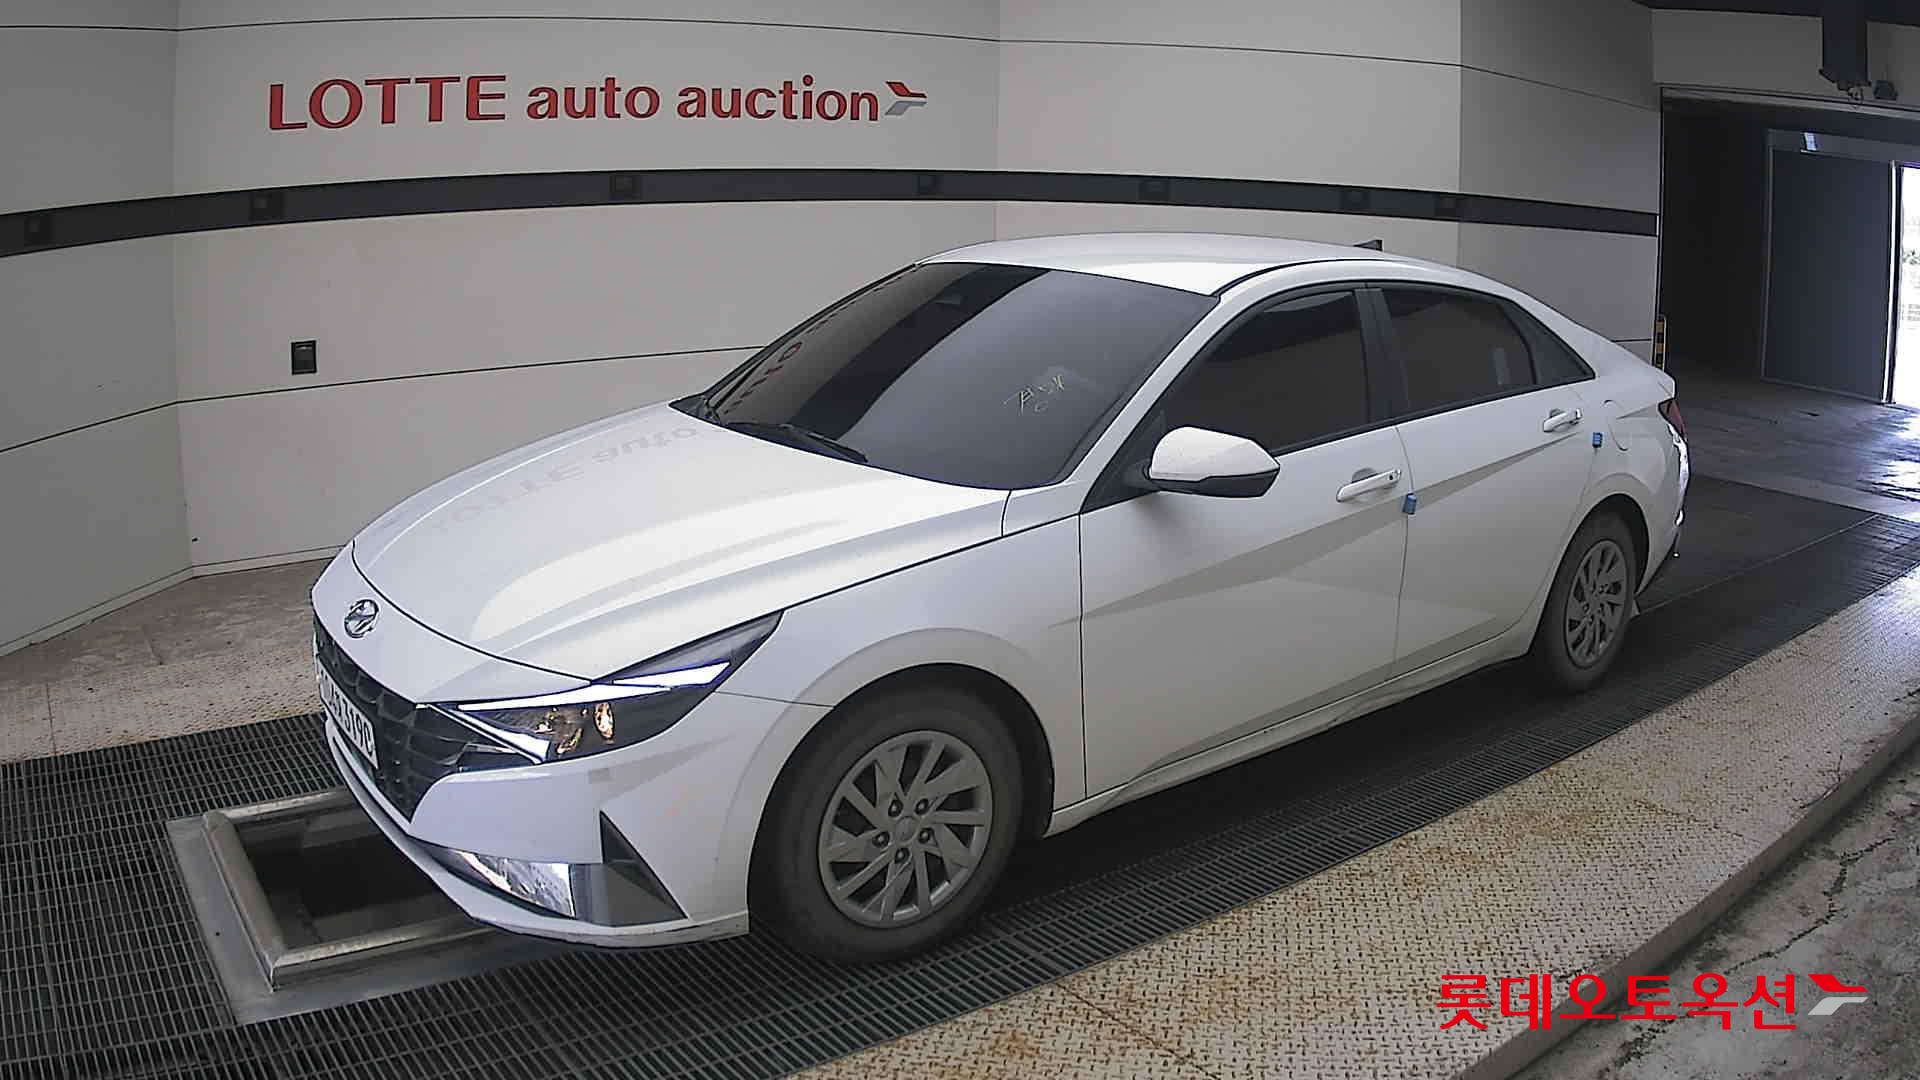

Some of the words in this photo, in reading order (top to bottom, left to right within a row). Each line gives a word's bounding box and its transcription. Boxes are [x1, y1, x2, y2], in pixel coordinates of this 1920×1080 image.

[268, 75, 506, 130] LOTTE
[526, 76, 661, 120] auto
[676, 74, 879, 121] auction
